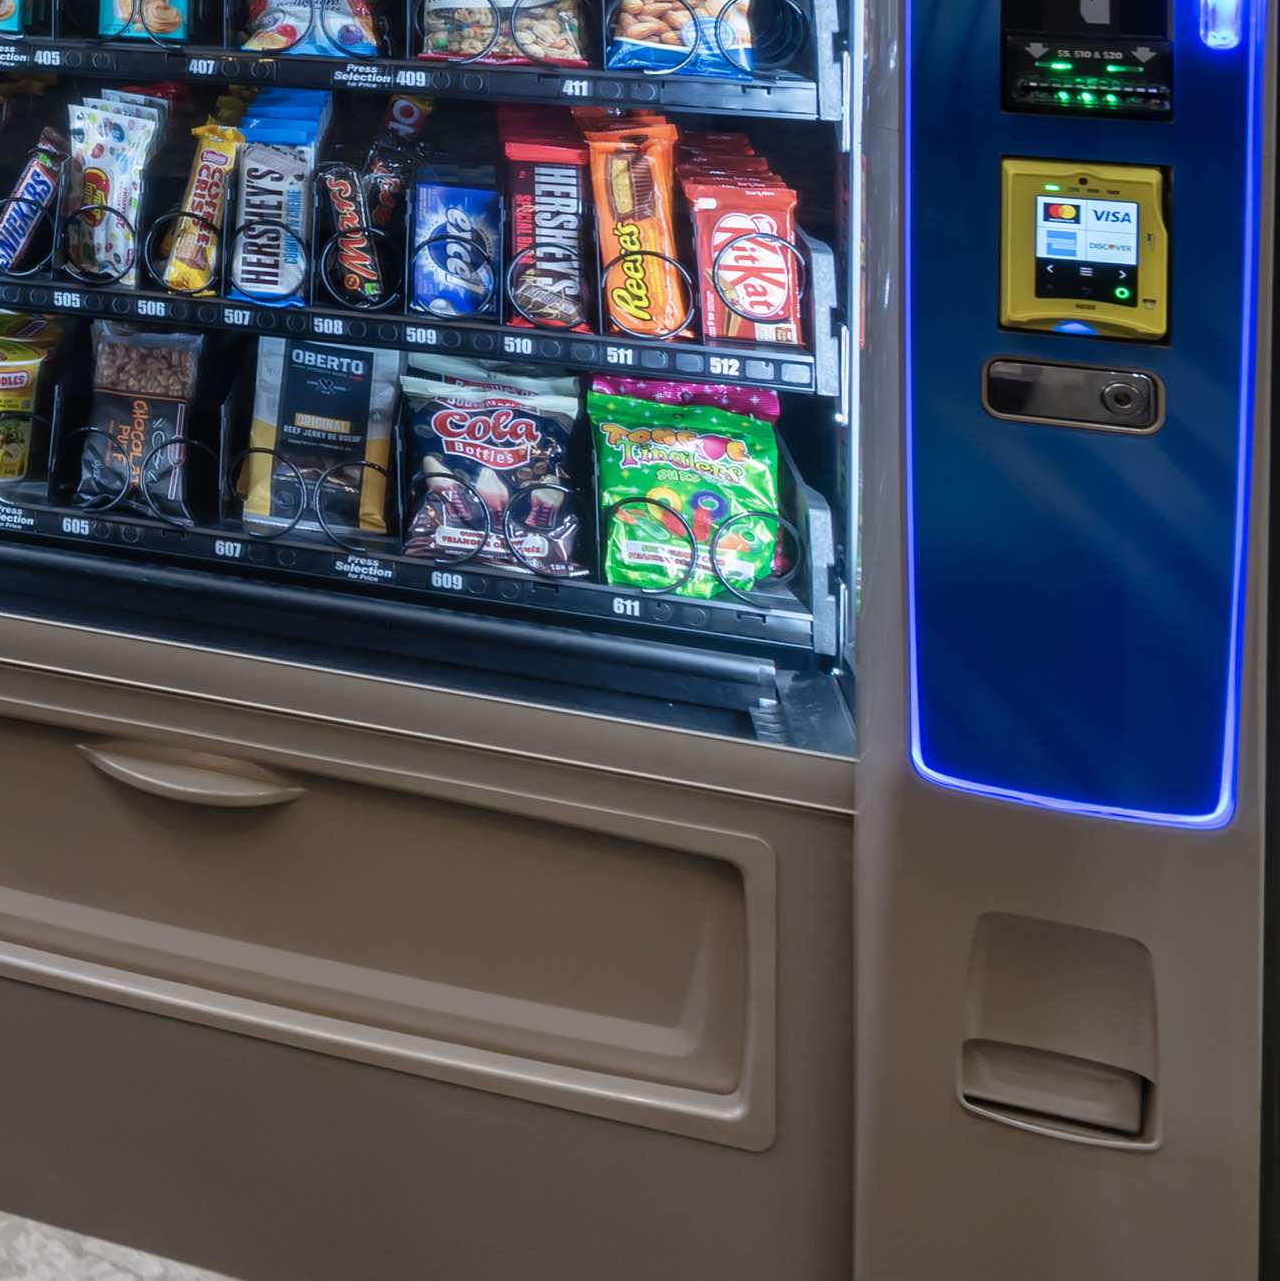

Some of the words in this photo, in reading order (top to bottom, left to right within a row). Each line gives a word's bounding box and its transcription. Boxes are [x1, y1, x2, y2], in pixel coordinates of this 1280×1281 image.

[33, 50, 61, 66] 405
[1074, 49, 1091, 59] $10
[1103, 50, 1123, 60] $20
[189, 59, 215, 75] 407
[346, 62, 378, 73] Press
[333, 69, 391, 84] Selection
[396, 71, 426, 87] 409
[562, 80, 588, 96] 411
[1092, 208, 1132, 224] VISA
[240, 167, 285, 286] HERSHEY'S
[534, 166, 580, 296] HERSHEY'S
[1089, 241, 1132, 253] DISCOVER
[612, 222, 653, 322] Reese's
[53, 291, 81, 308] 505
[137, 300, 166, 317] 506
[224, 308, 252, 325] 507
[313, 318, 344, 335] 508
[405, 327, 437, 345] 509
[504, 338, 533, 355] 510
[291, 348, 364, 375] OBERTO
[606, 347, 633, 365] 511
[709, 358, 740, 376] 512
[431, 408, 542, 449] Cola
[453, 440, 515, 465] Bottles
[62, 518, 89, 535] 605
[214, 540, 241, 558] 607
[334, 560, 392, 578] Selection
[347, 555, 379, 567] Press
[431, 572, 462, 590] 609
[612, 598, 640, 616] 611
